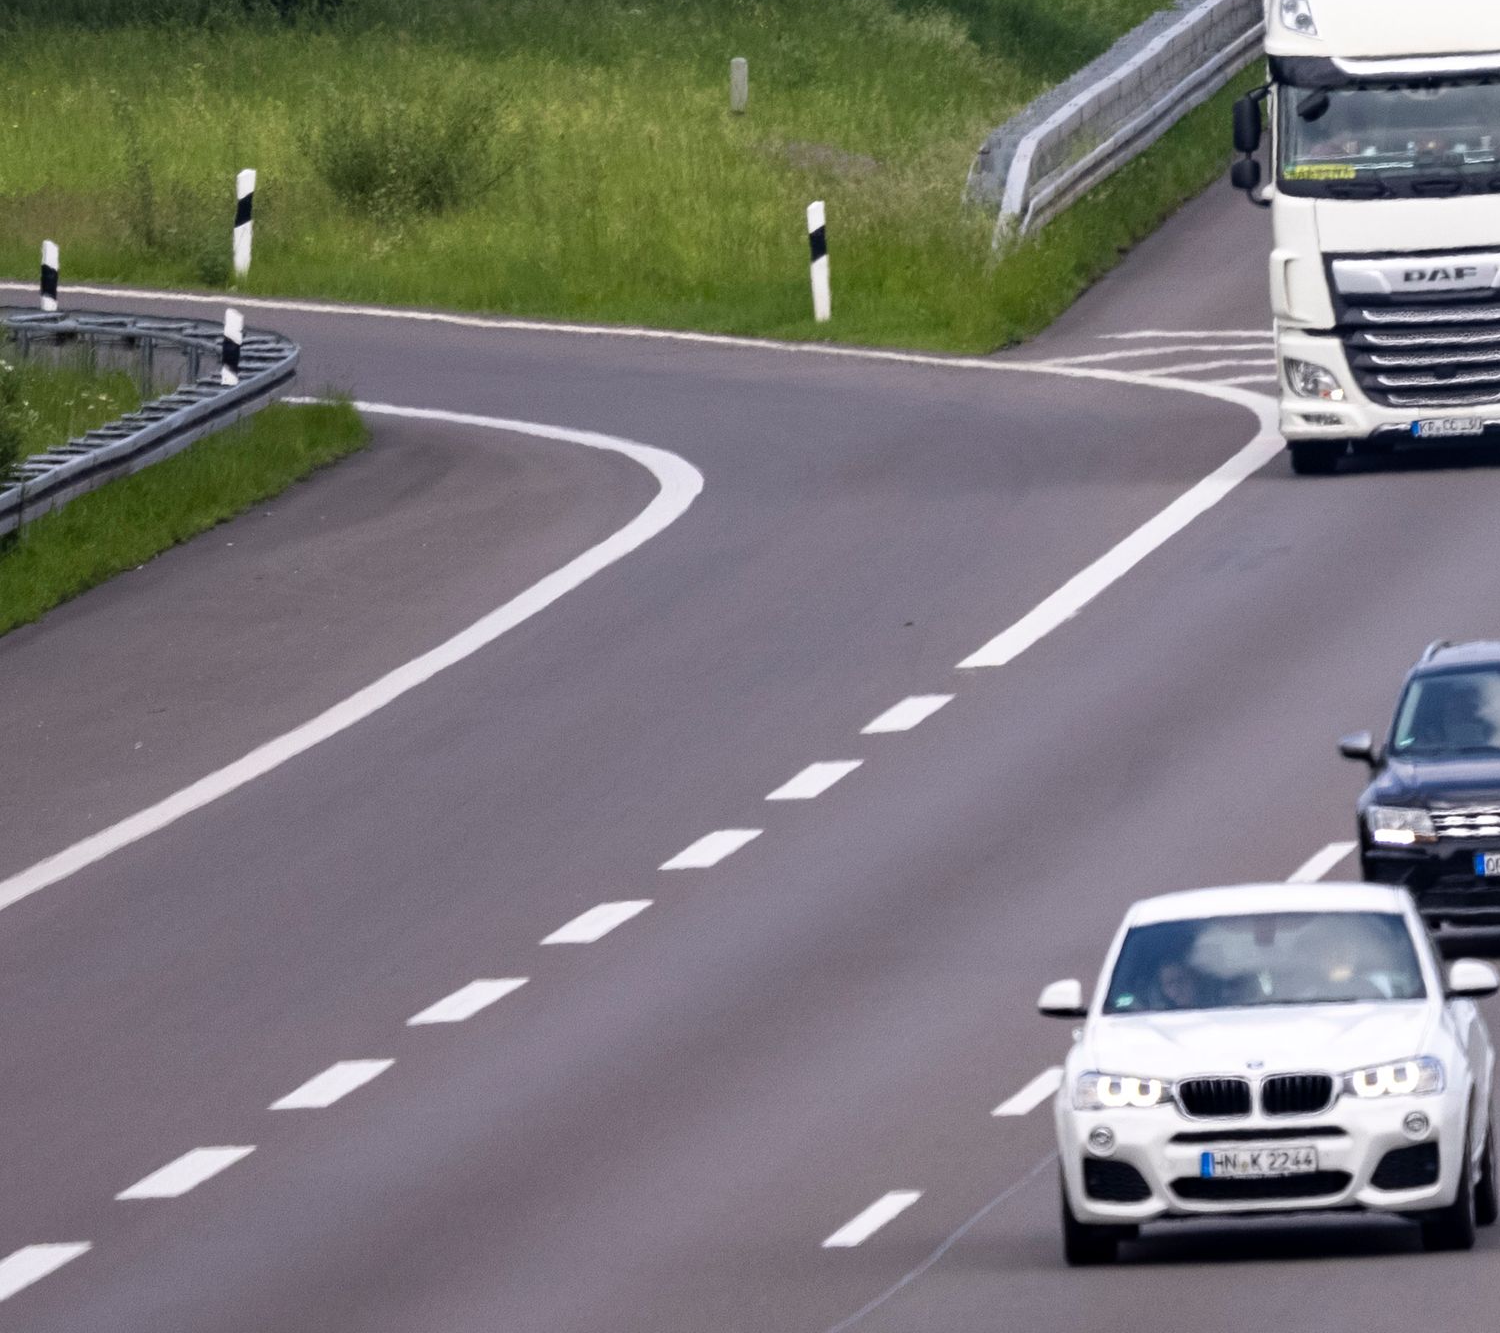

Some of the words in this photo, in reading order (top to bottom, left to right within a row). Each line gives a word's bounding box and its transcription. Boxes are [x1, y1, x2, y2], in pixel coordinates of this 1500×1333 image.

[1403, 267, 1478, 283] DAF
[1215, 1153, 1237, 1174] HN
[1250, 1152, 1262, 1171] K
[1267, 1151, 1314, 1171] 2244
